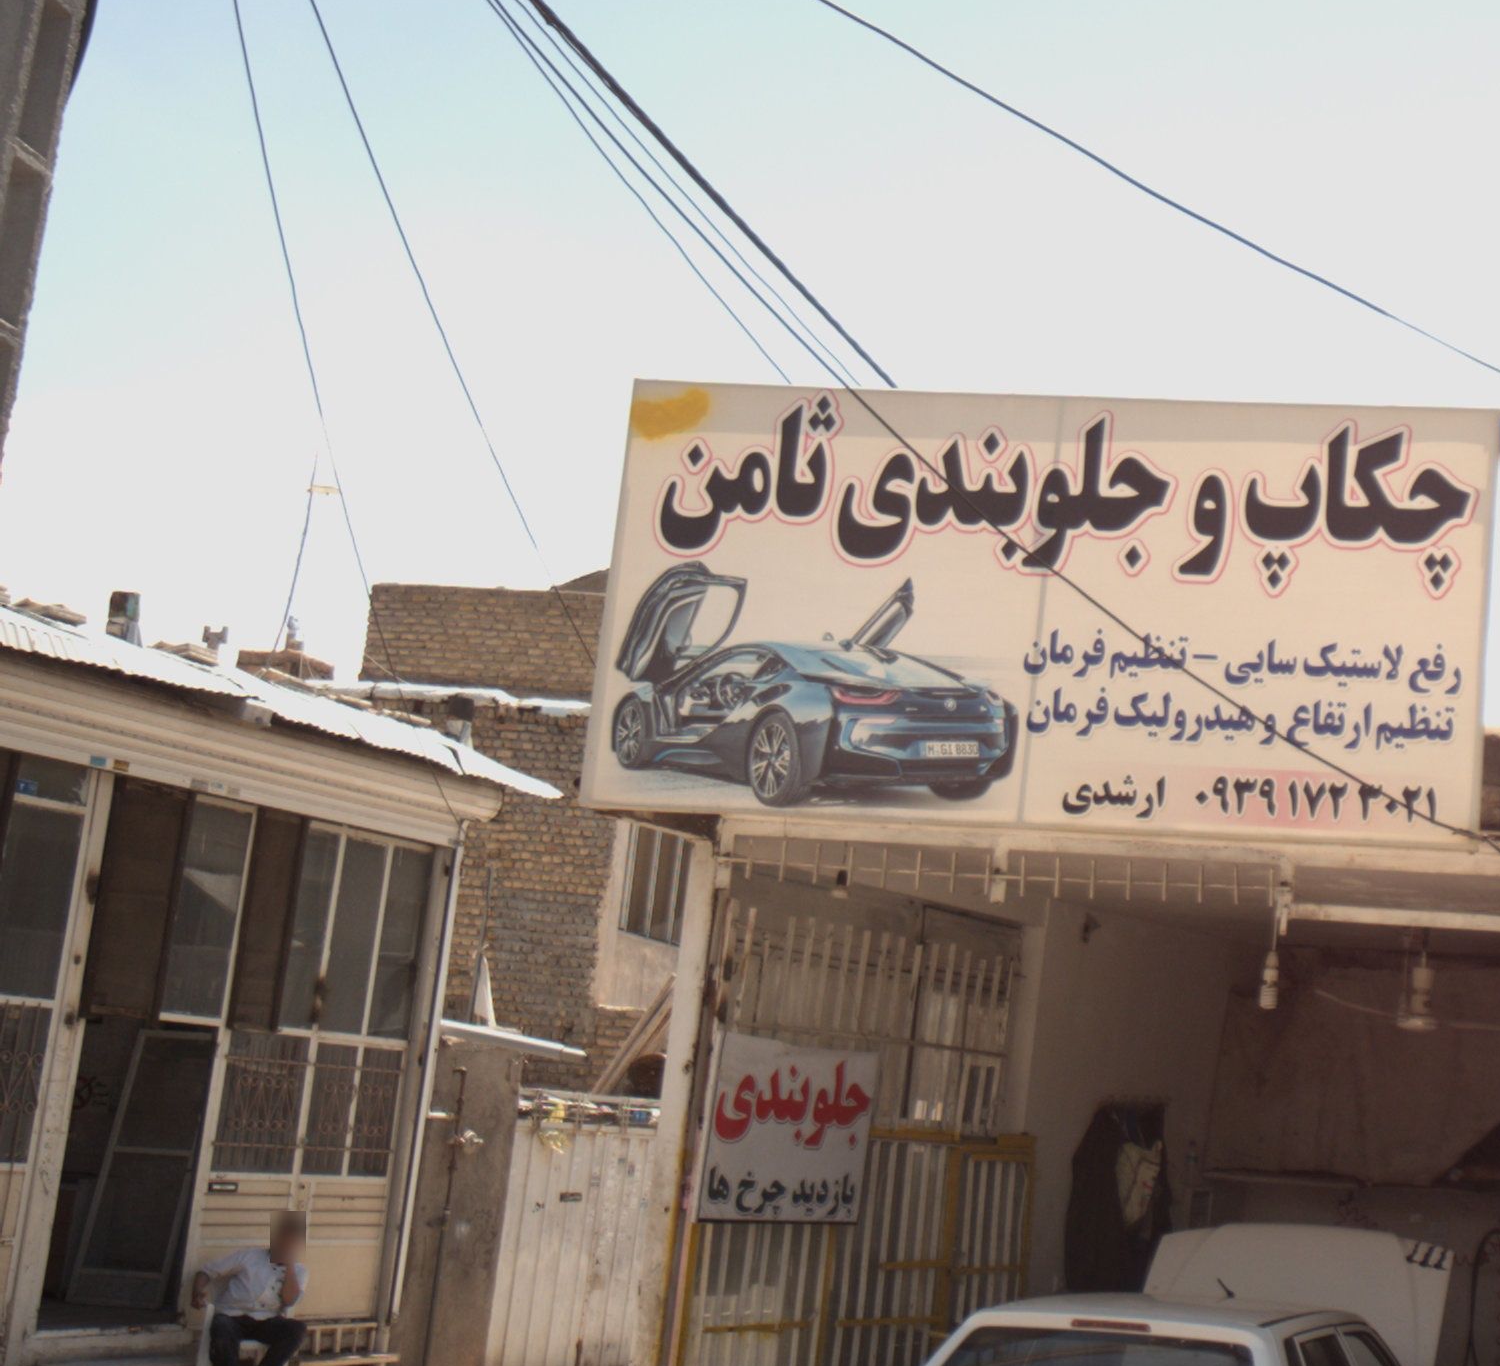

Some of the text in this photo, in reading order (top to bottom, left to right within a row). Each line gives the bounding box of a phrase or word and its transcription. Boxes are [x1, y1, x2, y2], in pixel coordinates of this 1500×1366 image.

[659, 395, 1472, 591] چکاپ و جلوبندی ثامن
[1022, 628, 1105, 678] فرمان
[1109, 634, 1188, 679] تنظیم
[1224, 639, 1297, 685] سایی
[1303, 641, 1403, 688] لاستیک
[1408, 642, 1461, 695] رفع
[1026, 686, 1455, 749] تنظیم ارتفاع و هیدرولیک فرمان
[1061, 774, 1166, 818] ارشدی
[714, 1059, 872, 1150] جلوبندی
[707, 1165, 856, 1217] بازدید چرخ ها
